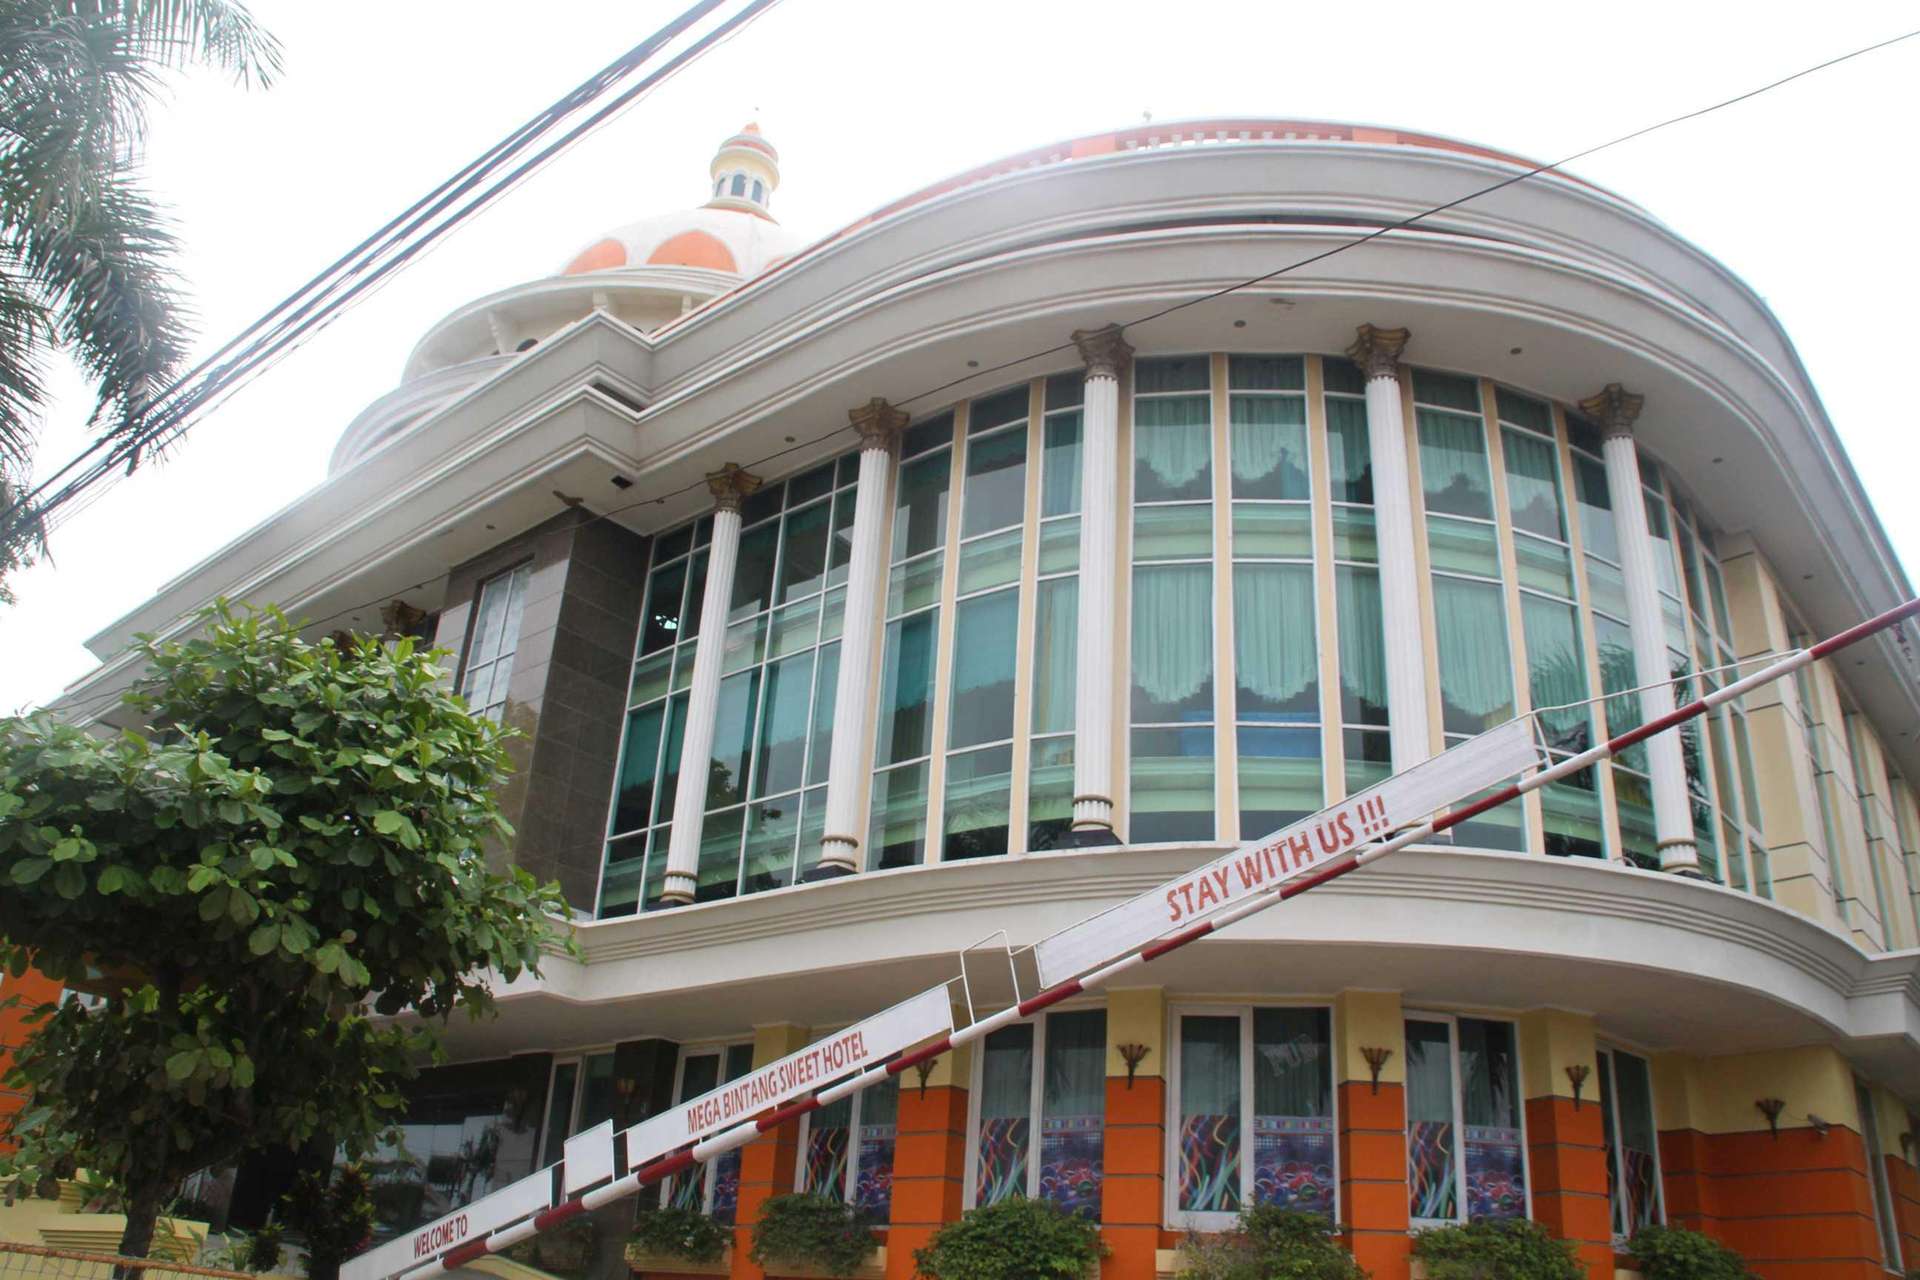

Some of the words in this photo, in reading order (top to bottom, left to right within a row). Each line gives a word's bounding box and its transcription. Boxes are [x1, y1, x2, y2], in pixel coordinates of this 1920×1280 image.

[1166, 866, 1230, 922] STAY
[1235, 831, 1314, 891] WITH
[1316, 811, 1354, 854] US
[687, 1102, 721, 1135] MEGA
[724, 1071, 777, 1119] BINTANG
[779, 1051, 821, 1093] SWEET
[823, 1031, 868, 1074] HOTEL
[414, 1221, 454, 1259] WELCOME
[456, 1214, 468, 1239] TO
